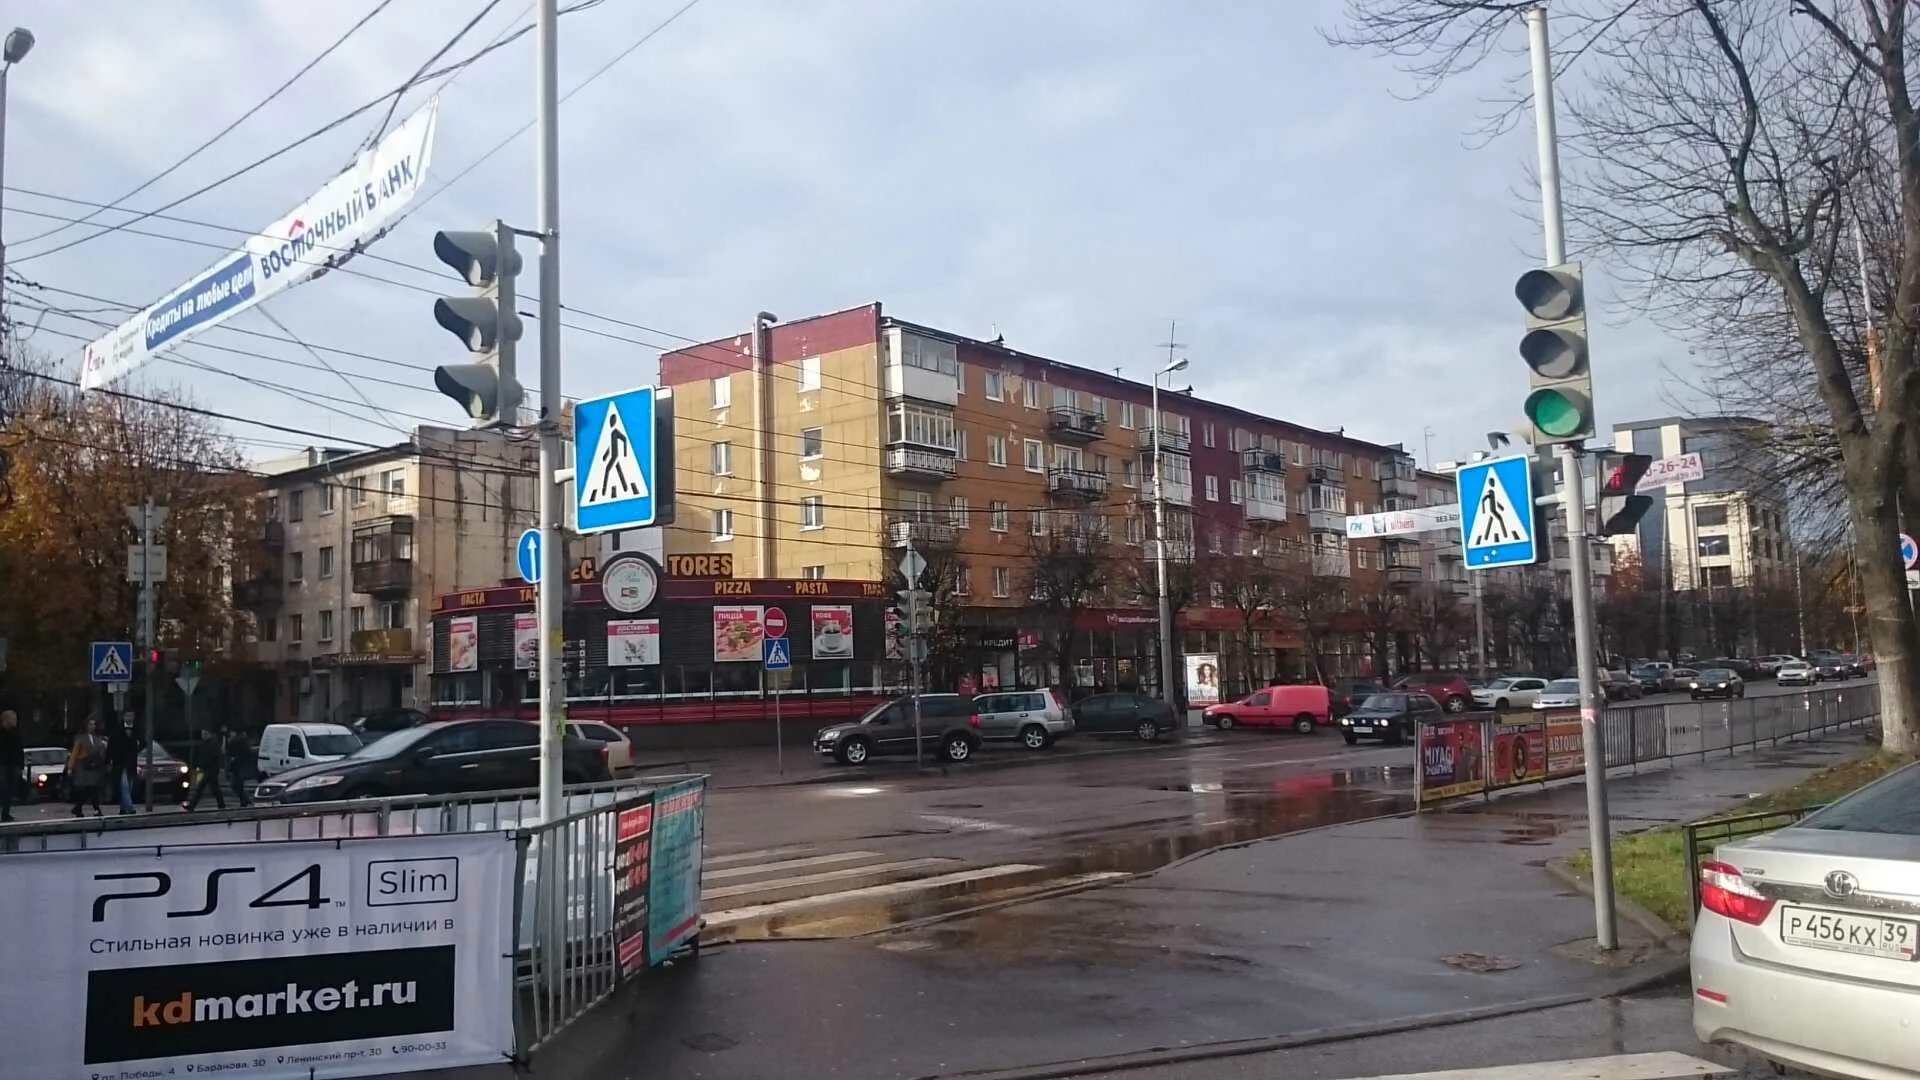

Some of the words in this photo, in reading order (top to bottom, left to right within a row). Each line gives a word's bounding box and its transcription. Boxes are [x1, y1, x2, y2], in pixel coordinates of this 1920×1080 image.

[365, 155, 413, 210] БАНК
[147, 304, 182, 340] Кредиты
[181, 297, 194, 319] на
[196, 280, 231, 312] любые
[231, 265, 254, 295] цели
[668, 555, 733, 577] TORES
[714, 581, 752, 595] PIZZA
[795, 582, 829, 595] PASTA
[91, 863, 331, 923] PS4
[379, 869, 448, 895] Slim
[89, 935, 192, 954] Стильная
[199, 929, 285, 947] новинка
[292, 926, 331, 943] уже
[338, 926, 348, 937] в
[355, 919, 437, 936] наличии
[444, 918, 454, 929] в
[1884, 923, 1907, 944] 39
[132, 978, 418, 1028] kdmarket.ru
[286, 1052, 342, 1065] Ленинский
[368, 1048, 382, 1057] 30
[400, 1041, 447, 1053] 90-00-33
